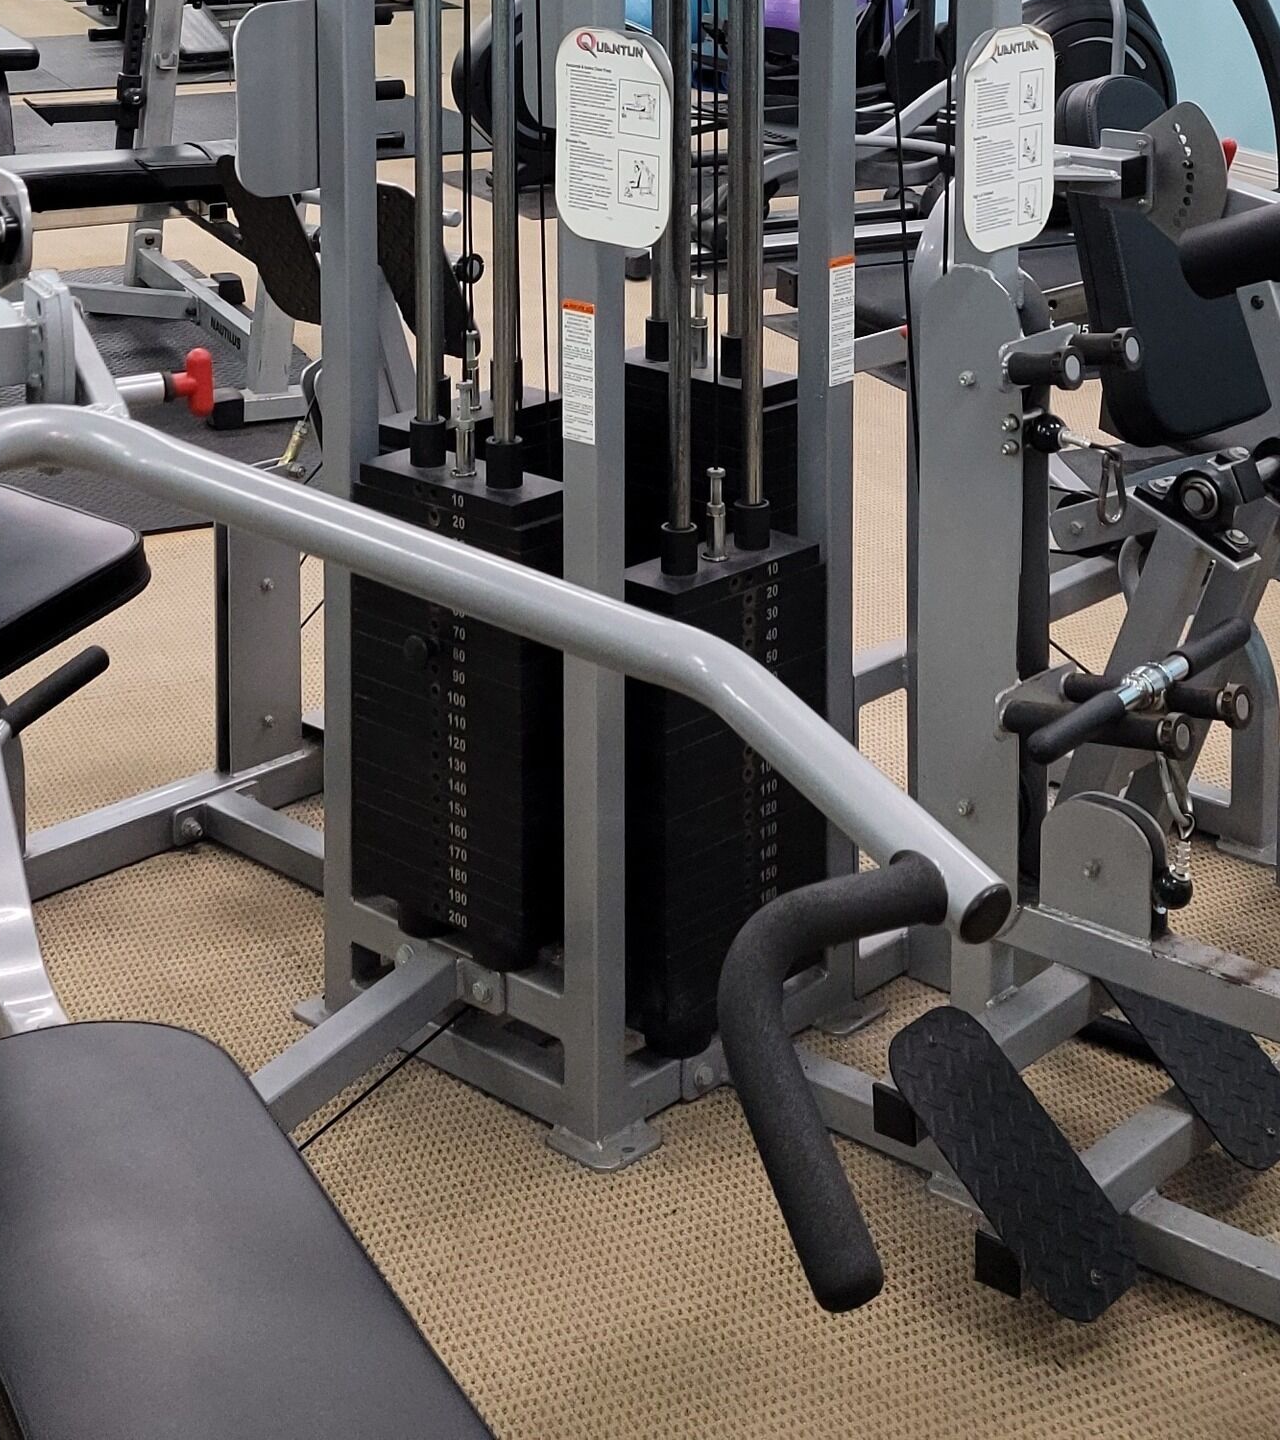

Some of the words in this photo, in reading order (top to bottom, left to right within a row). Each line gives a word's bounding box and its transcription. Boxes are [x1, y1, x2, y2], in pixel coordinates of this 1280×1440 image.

[210, 316, 241, 350] NAUTILUS
[451, 493, 464, 508] 10
[452, 515, 466, 530] 20
[767, 561, 779, 577] 10
[766, 584, 779, 599] 20
[766, 606, 778, 621] 30
[452, 625, 466, 641] 70
[766, 627, 778, 641] 40
[766, 649, 778, 664] 50
[452, 669, 466, 685] 90
[447, 690, 466, 708] 100
[447, 712, 467, 731] 110
[447, 733, 466, 753] 120
[447, 756, 467, 774] 130
[448, 777, 467, 796] 140
[760, 778, 778, 797] 110
[448, 799, 467, 818] 150
[760, 800, 778, 818] 120
[448, 821, 468, 840] 160
[448, 844, 468, 862] 170
[760, 843, 778, 862] 140
[760, 865, 778, 884] 150
[448, 909, 468, 928] 200
